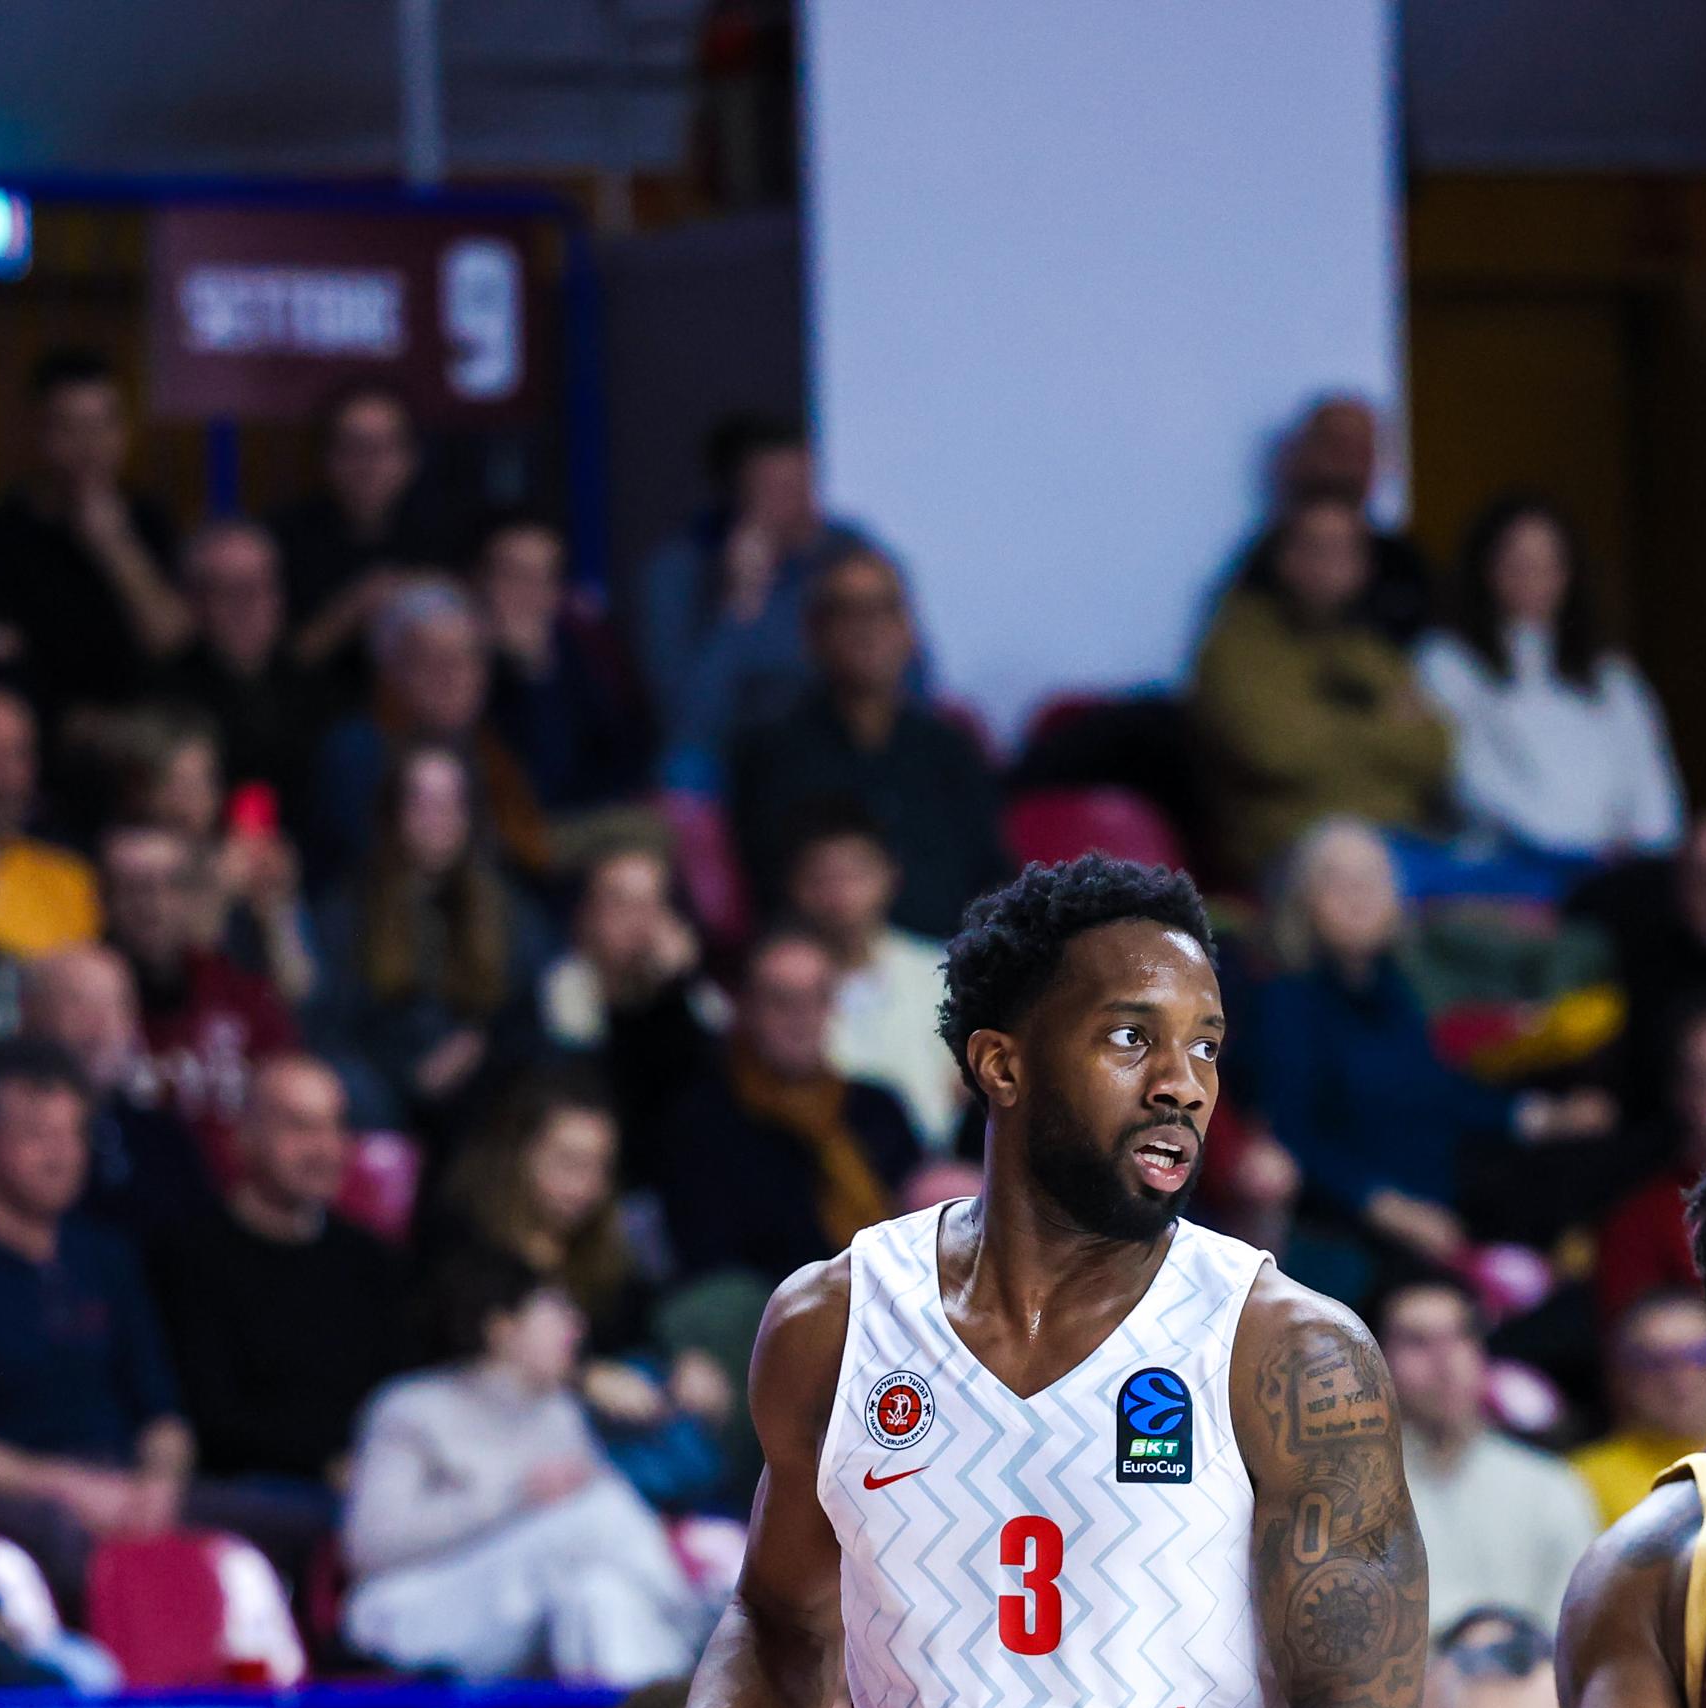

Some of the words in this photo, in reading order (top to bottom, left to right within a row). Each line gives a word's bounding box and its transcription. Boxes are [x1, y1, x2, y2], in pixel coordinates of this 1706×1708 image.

[440, 237, 524, 401] 9
[870, 1416, 885, 1442] HAPOEL
[885, 1431, 921, 1445] JERUSALEM
[1130, 1440, 1179, 1455] BKT
[1122, 1460, 1186, 1477] EuroCup
[998, 1515, 1064, 1656] 3
